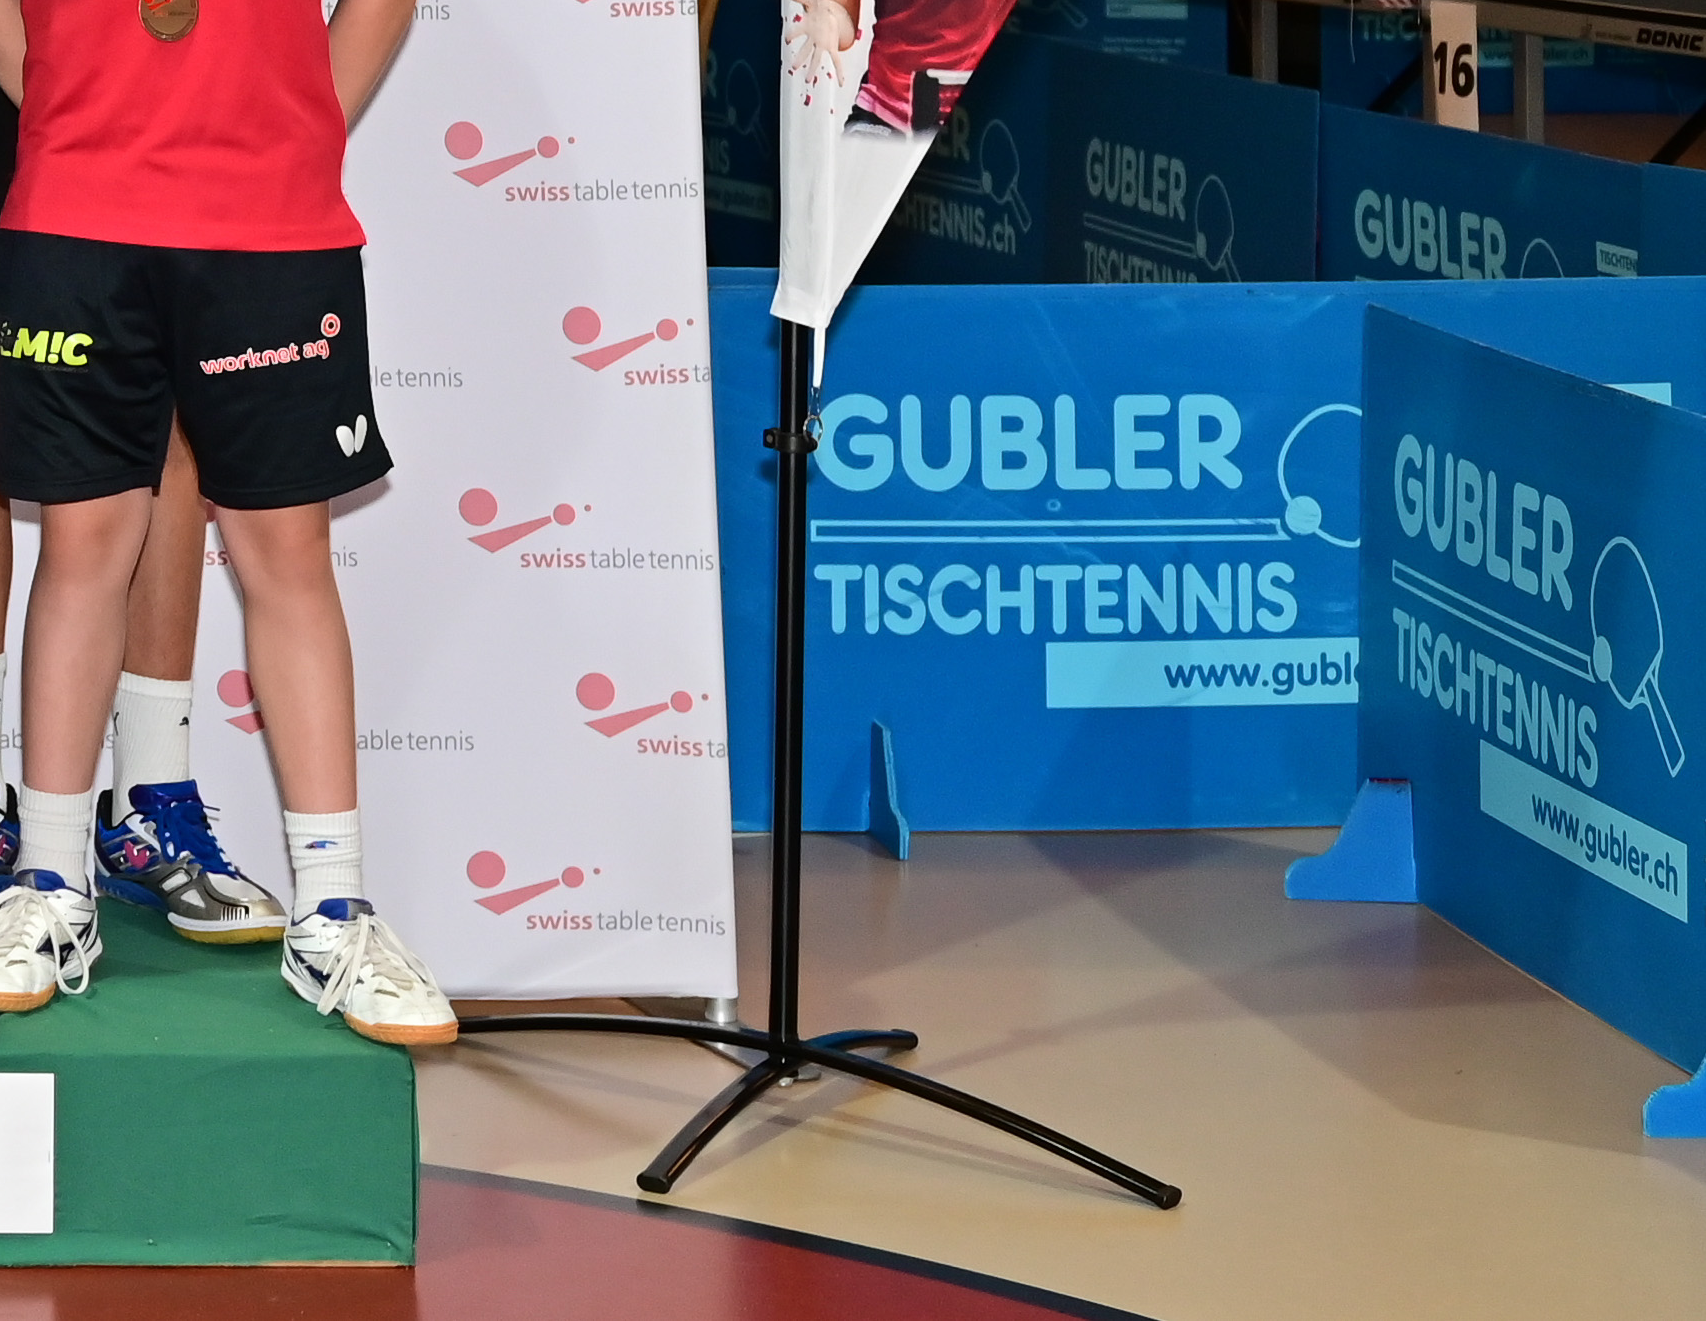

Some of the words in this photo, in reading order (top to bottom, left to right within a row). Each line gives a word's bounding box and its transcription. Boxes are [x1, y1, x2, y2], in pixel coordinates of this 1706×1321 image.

[1434, 42, 1475, 98] 16
[1636, 27, 1704, 52] DONIC
[1087, 137, 1187, 222] GUBLER
[1355, 189, 1507, 280] GUBLER
[200, 342, 298, 375] worknet
[302, 339, 330, 363] ag
[815, 392, 1243, 491] GUBLER
[1393, 432, 1574, 612] GUBLER
[814, 562, 1298, 636] TISCHTENNIS
[1392, 606, 1599, 790] TISCHTENNIS
[1531, 791, 1680, 897] www.gubler.ch
